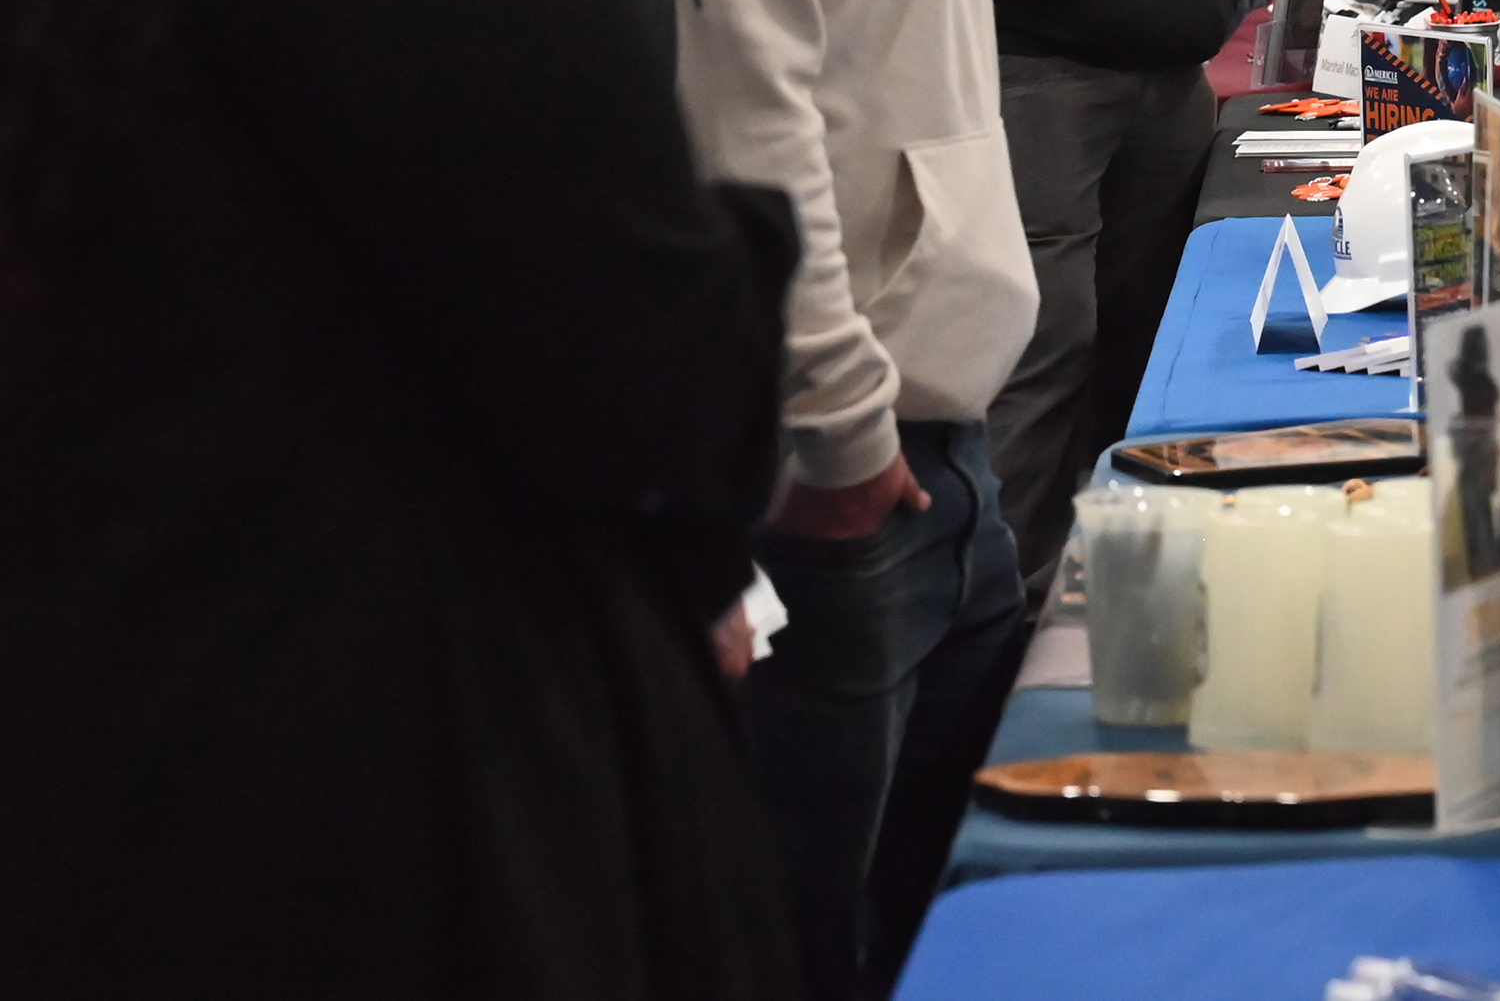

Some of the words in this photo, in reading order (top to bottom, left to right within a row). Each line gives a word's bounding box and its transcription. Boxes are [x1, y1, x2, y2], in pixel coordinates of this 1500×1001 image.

[1374, 69, 1398, 81] MERICLE
[1365, 86, 1379, 100] WE
[1382, 88, 1399, 102] ARE
